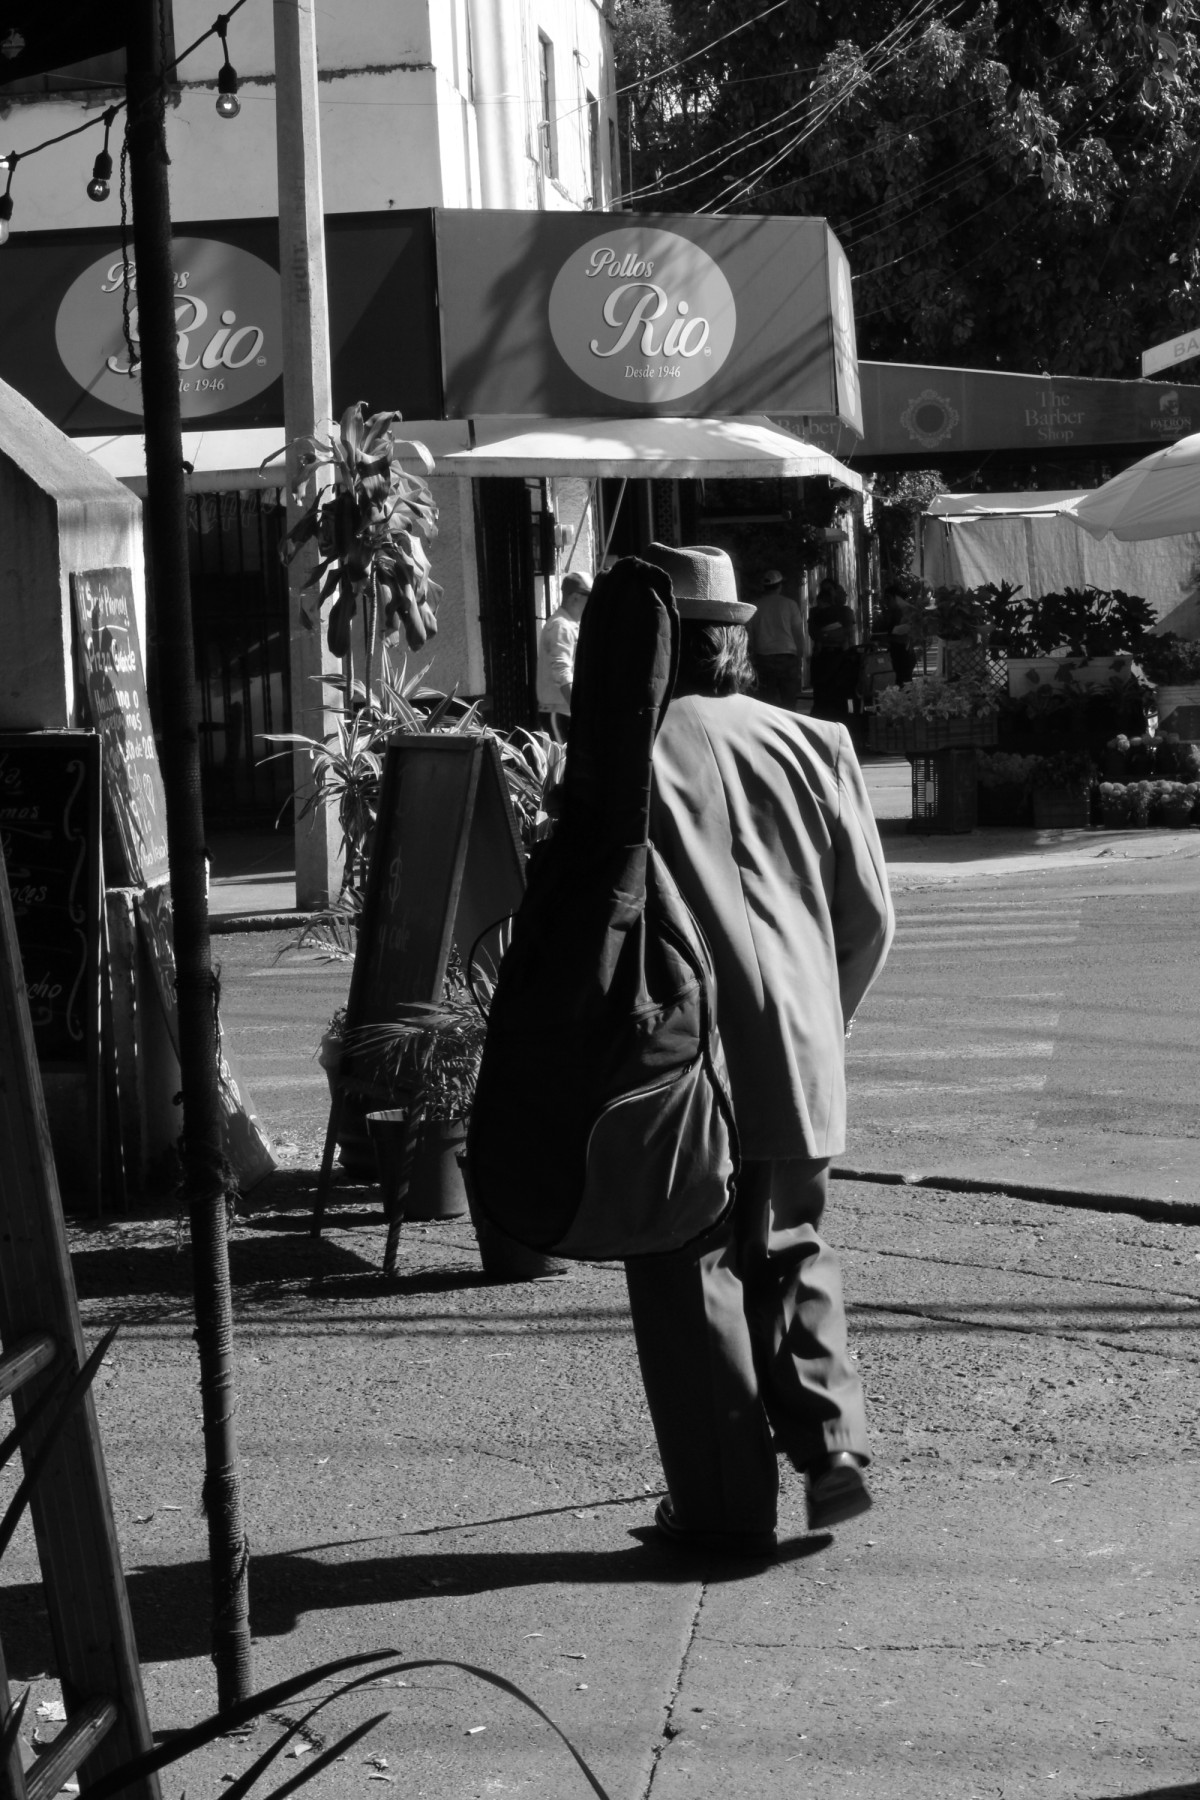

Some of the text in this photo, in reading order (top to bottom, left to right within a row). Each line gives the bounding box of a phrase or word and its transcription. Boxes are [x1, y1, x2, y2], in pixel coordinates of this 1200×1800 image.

[585, 247, 655, 278] Pollos
[589, 282, 710, 358] Rio
[624, 365, 681, 378] Desde 1946
[195, 377, 225, 392] 1946
[1034, 391, 1070, 407] The
[1024, 408, 1086, 426] Barber
[1038, 427, 1074, 443] Shop
[26, 970, 62, 999] cho
